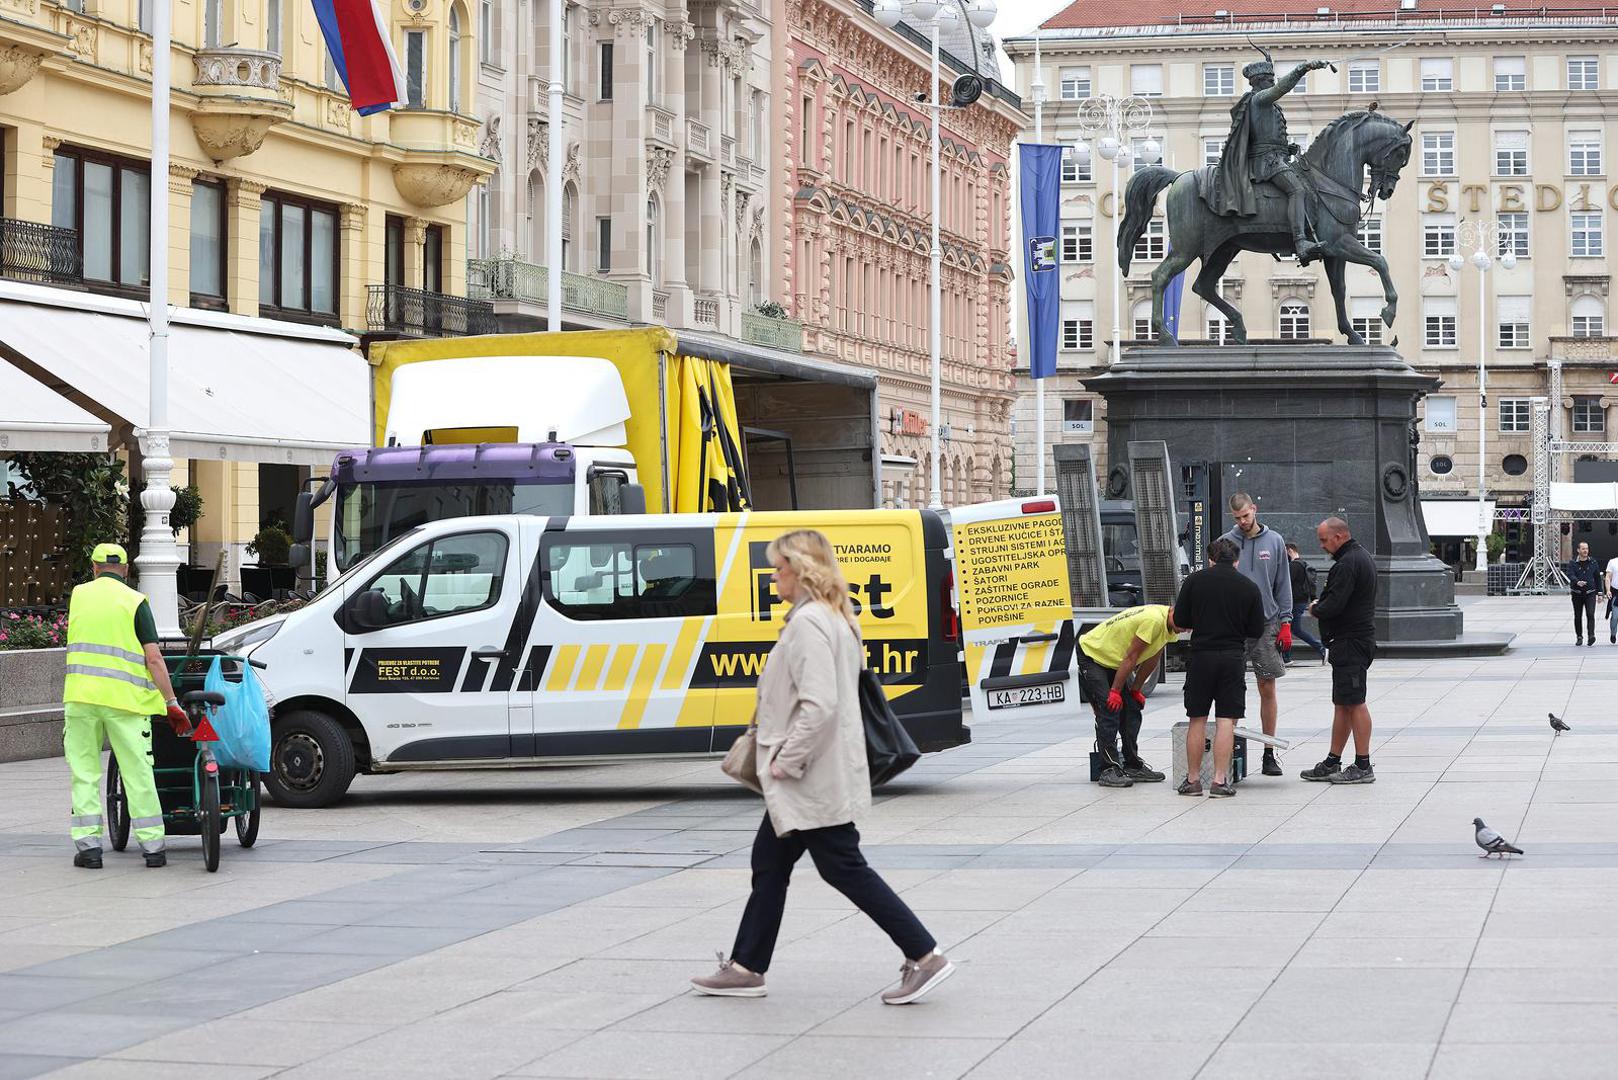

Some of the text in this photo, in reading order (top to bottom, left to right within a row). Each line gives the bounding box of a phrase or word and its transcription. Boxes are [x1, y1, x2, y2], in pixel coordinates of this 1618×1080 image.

[968, 521, 1030, 535] EKSKLUZIVNE
[969, 535, 1006, 545] DRVENE
[970, 545, 1008, 555] STRUJNI
[1011, 541, 1046, 552] SISTEMI
[1053, 538, 1065, 546] AG
[834, 544, 891, 554] TVARAMO
[971, 548, 1066, 565] UGOSTITELJSKA OPR
[972, 562, 1040, 575] ZABAVNI PARK
[974, 575, 1007, 585] ŠATORI
[975, 579, 1059, 595] ZAŠTITNE OGRADE
[758, 574, 895, 622] Fst
[976, 593, 1028, 605] POZORNICE
[977, 604, 1018, 614] POKROVI
[1034, 599, 1064, 607] RAZNE
[978, 612, 1024, 624] POVRŠINE
[378, 667, 440, 675] FEST d.o.o.
[996, 686, 1062, 704] KA 223-HB
